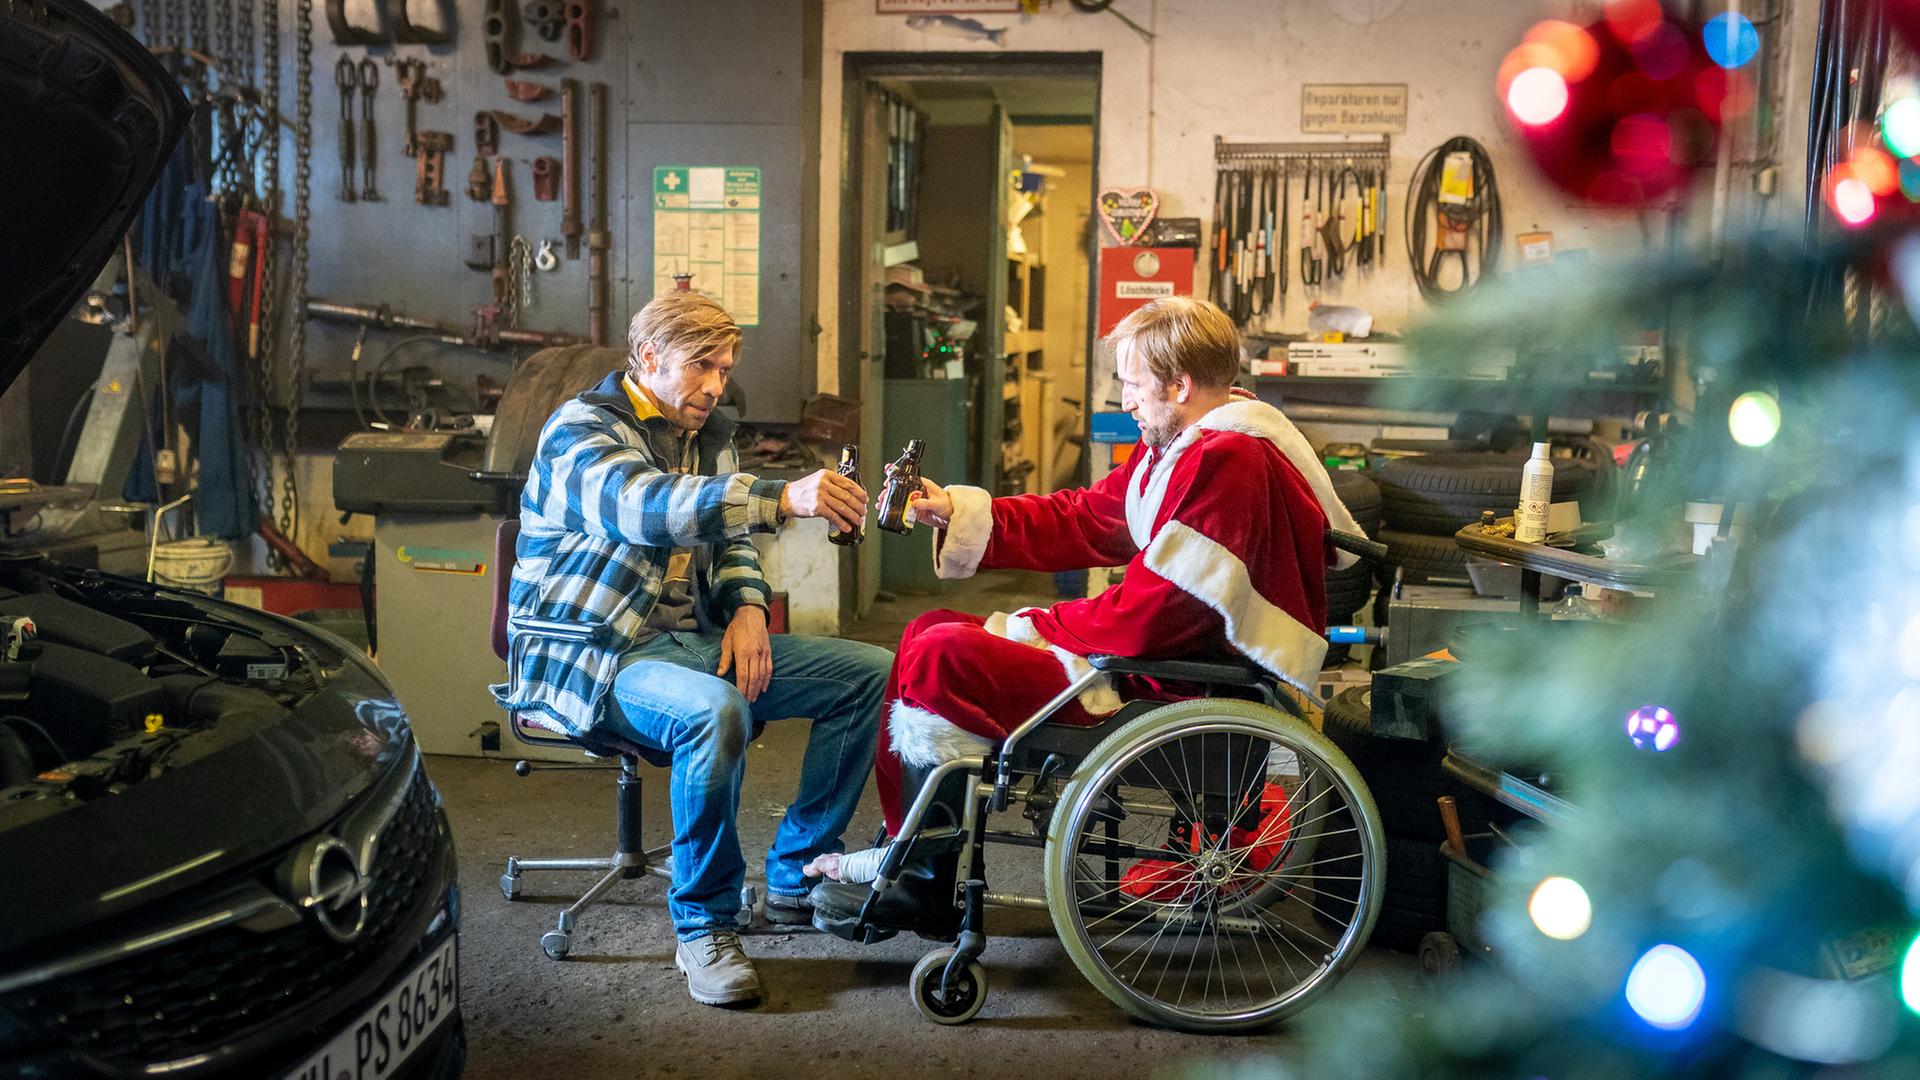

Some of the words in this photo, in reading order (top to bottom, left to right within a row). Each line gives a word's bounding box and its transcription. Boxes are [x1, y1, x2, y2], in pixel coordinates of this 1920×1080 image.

[1305, 92, 1379, 108] Reparaturen
[1382, 95, 1400, 105] nur
[1305, 114, 1337, 127] gegen
[1341, 110, 1405, 127] Barzahlung
[1120, 284, 1170, 295] Löschdecke
[355, 1003, 390, 1080] PS
[398, 946, 454, 1052] 8634
